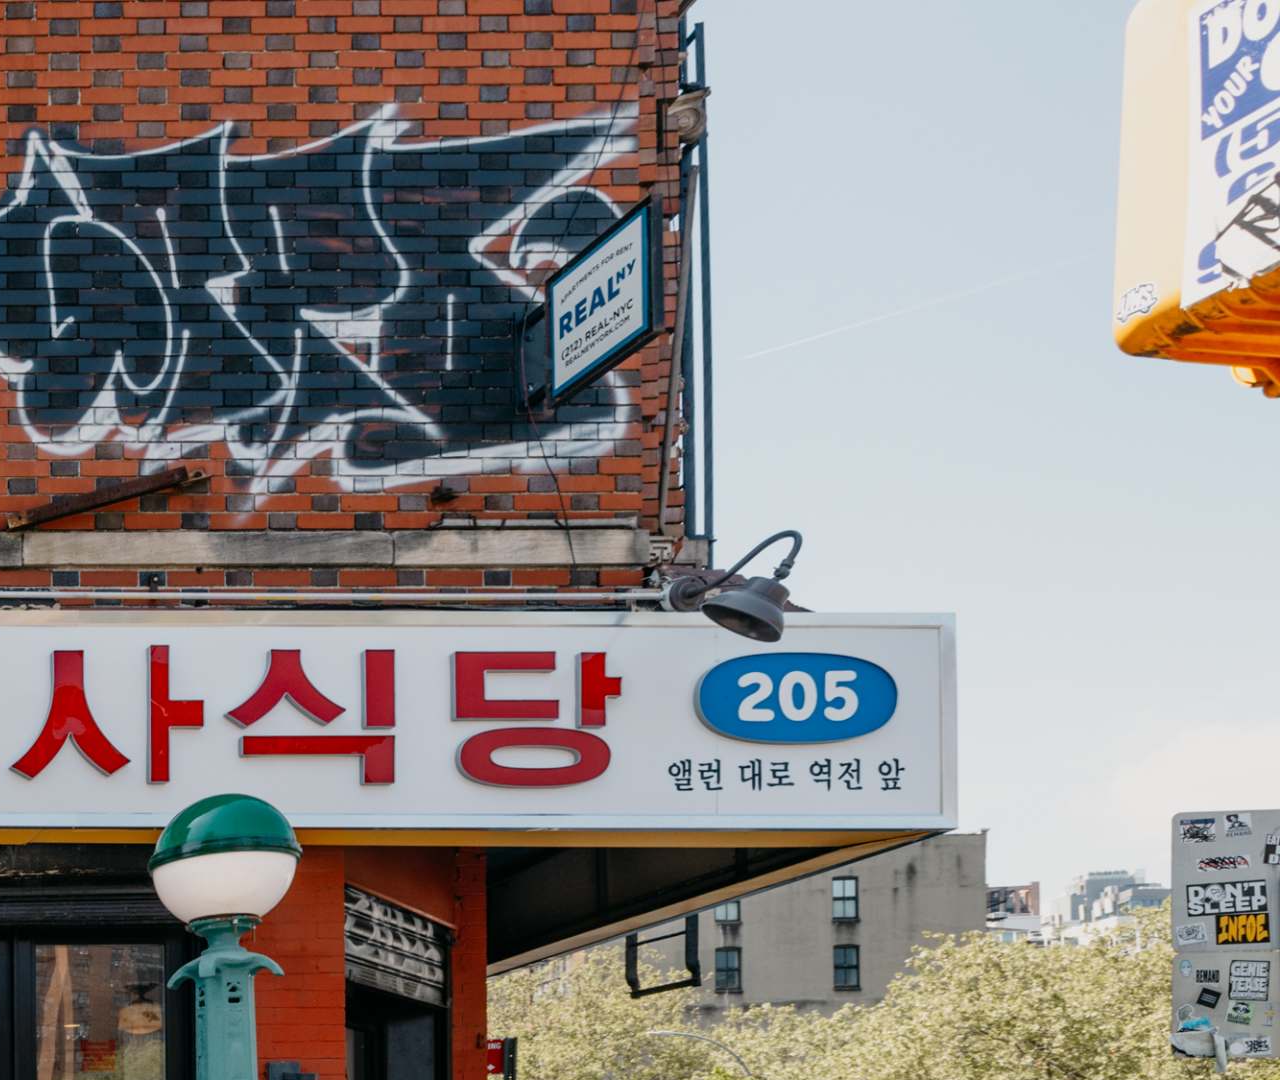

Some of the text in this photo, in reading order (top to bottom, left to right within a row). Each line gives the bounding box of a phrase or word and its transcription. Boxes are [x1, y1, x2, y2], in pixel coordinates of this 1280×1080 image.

[1202, 55, 1260, 129] YOUR
[560, 243, 634, 304] APARTMENTS FOR RENT
[561, 298, 633, 360] (212) REAL-NYC
[565, 315, 630, 367] REALNEWYORK.COM
[738, 669, 860, 722] 205
[668, 758, 906, 791] 앨런 대로 역전 앞
[1188, 896, 1267, 916] SLEEP
[1217, 914, 1269, 944] INFOE
[1196, 970, 1220, 983] REMAND
[1231, 978, 1269, 993] TEASE
[1232, 961, 1269, 977] GENIE
